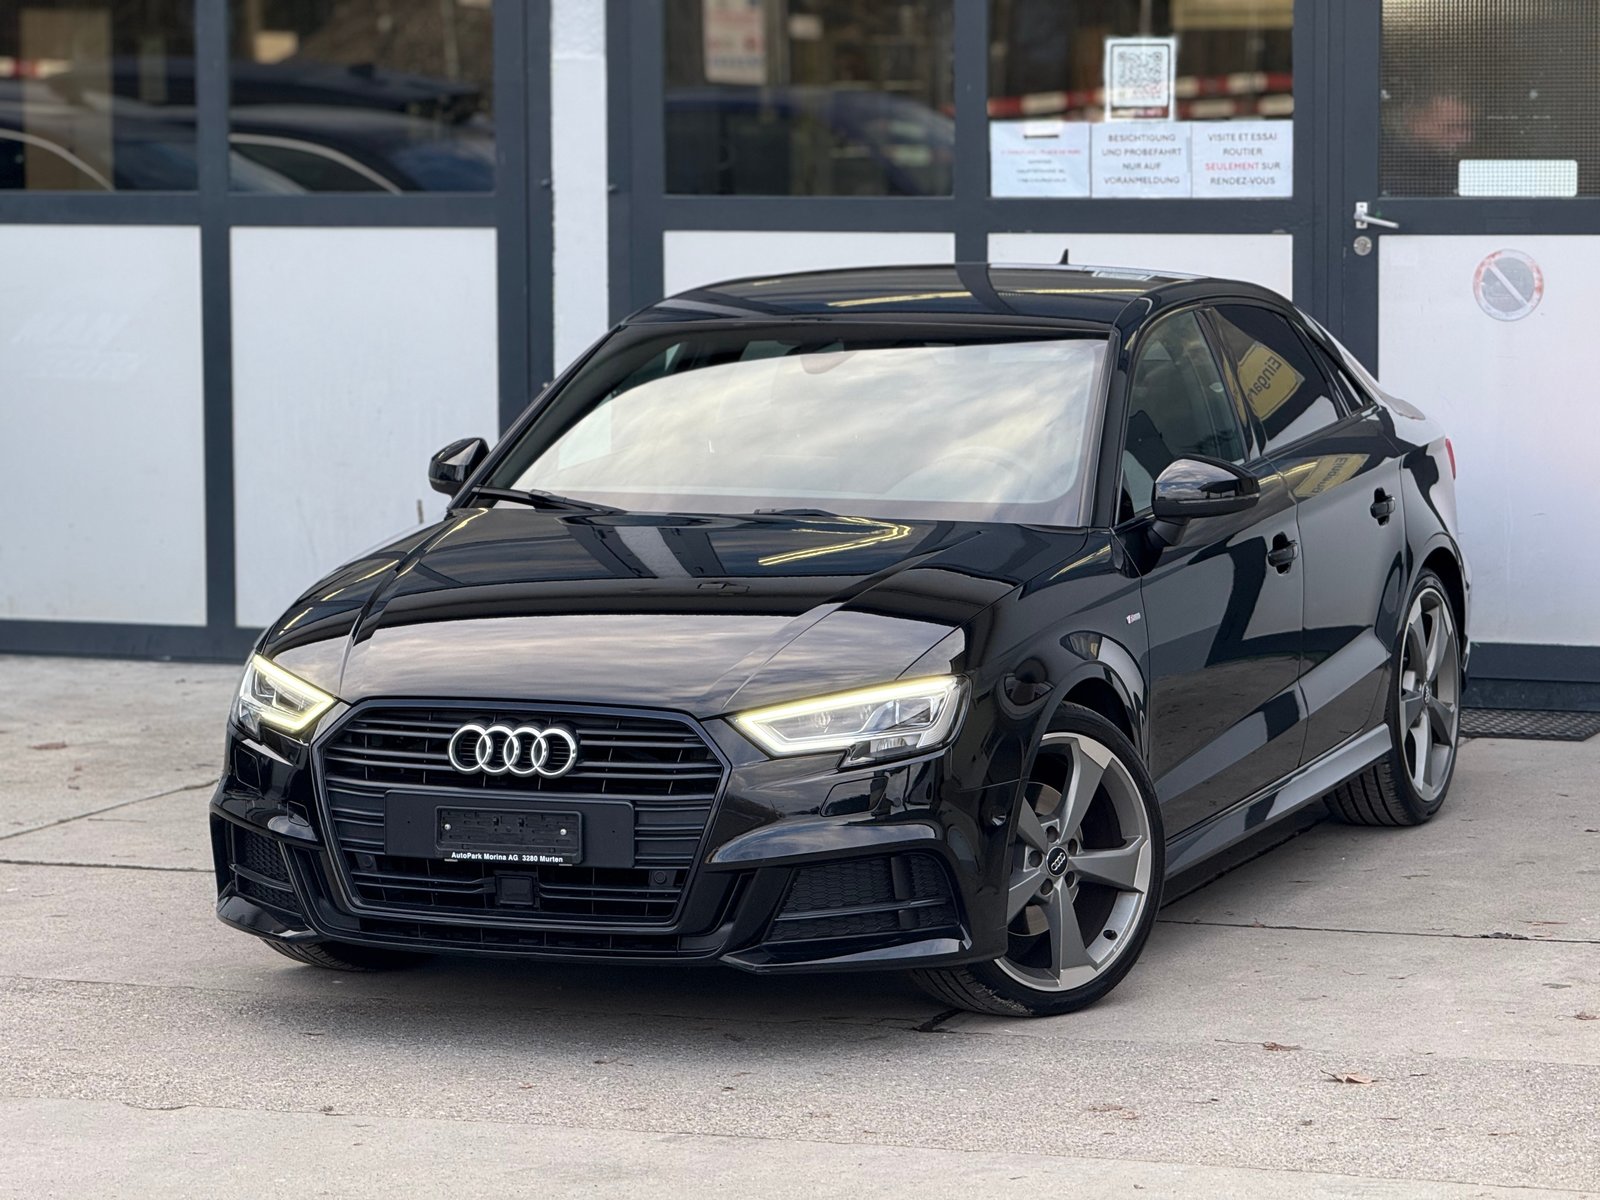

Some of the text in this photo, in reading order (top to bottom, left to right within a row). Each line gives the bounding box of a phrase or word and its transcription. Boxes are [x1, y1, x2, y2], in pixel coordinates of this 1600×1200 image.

[1108, 133, 1176, 142] BESICHTIGUNG
[1207, 133, 1277, 141] VISITE ET ESSAI
[1102, 147, 1182, 156] UND PROBEFAHRT
[1223, 148, 1263, 156] ROUTIER
[1122, 162, 1161, 170] NUR AUF
[1205, 162, 1280, 171] SEULEMENT SUR
[1103, 176, 1180, 185] VORANMELDUNG
[1210, 177, 1275, 185] RENDEZ-VOUS
[451, 852, 482, 860] AutoPark
[484, 853, 507, 861] Morina
